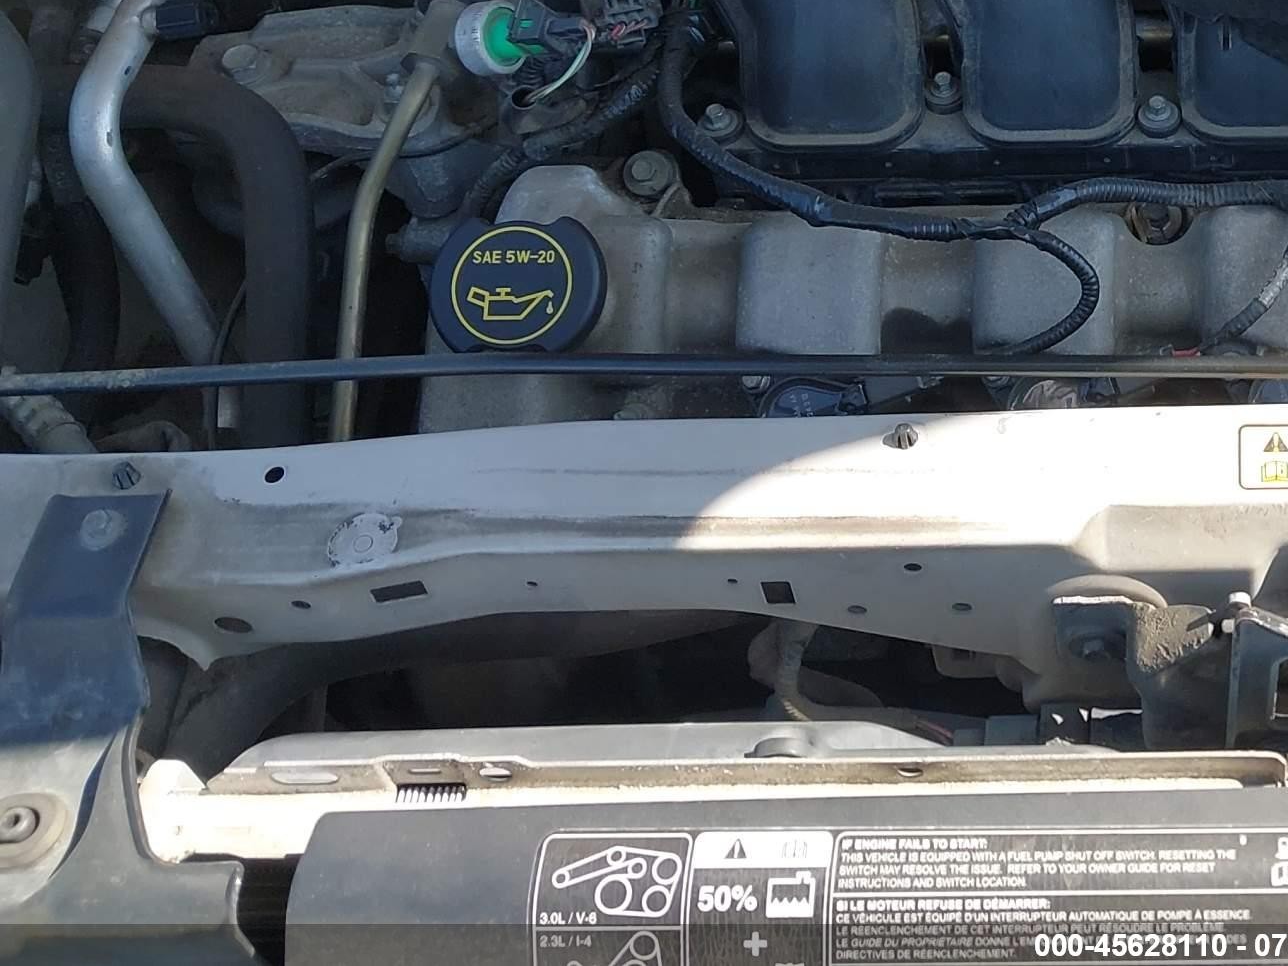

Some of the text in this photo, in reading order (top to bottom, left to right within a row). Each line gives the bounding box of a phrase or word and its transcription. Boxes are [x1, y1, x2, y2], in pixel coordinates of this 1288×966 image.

[472, 250, 555, 264] SAE 5W-20
[855, 839, 898, 850] ENGINE
[899, 839, 930, 850] FAILS
[933, 839, 948, 849] TO
[950, 839, 987, 849] START:
[841, 853, 863, 863] THIS
[865, 852, 907, 862] VEHICLE
[909, 852, 918, 862] IS
[920, 852, 971, 862] EQUIPPED
[972, 852, 997, 862] WITH
[999, 852, 1007, 862] A
[1008, 852, 1032, 861] FUEL
[1035, 851, 1063, 861] PUMP
[1064, 851, 1093, 861] SHUT
[1094, 850, 1114, 861] OFF
[1159, 850, 1215, 860] RESETTING
[1216, 850, 1236, 860] THE
[840, 865, 878, 875] SWITCH
[880, 865, 901, 875] MAY
[902, 864, 947, 875] RESOLVE
[950, 864, 969, 874] THE
[1008, 864, 1041, 874] REFER
[1043, 864, 1057, 874] TO
[1058, 863, 1087, 874] YOUR
[1088, 863, 1126, 873] OWNER
[1127, 863, 1158, 873] GUIDE
[1160, 863, 1181, 873] FOR
[1183, 863, 1216, 873] RESET
[838, 878, 911, 888] INSTRUCTIONS
[913, 877, 934, 888] AND
[936, 877, 974, 888] SWITCH
[697, 885, 758, 912] 50%
[836, 900, 848, 911] SI
[850, 900, 864, 911] LE
[867, 899, 915, 911] MOTEUR
[917, 899, 963, 910] REFUSE
[965, 899, 981, 910] DE
[540, 912, 566, 924] 3.0L
[576, 912, 597, 924] V-6
[836, 913, 850, 924] CE
[904, 913, 922, 923] EST
[990, 911, 1067, 922] INTERRUPTEUR
[1069, 910, 1139, 921] AUTOMATIQUE
[1141, 910, 1155, 921] DE
[1157, 910, 1192, 920] POMPE
[836, 926, 848, 936] LE
[955, 925, 970, 934] DE
[540, 936, 565, 948] 2.3L
[836, 938, 848, 947] LE
[851, 938, 882, 947] GUIDE
[885, 937, 899, 947] DU
[836, 950, 895, 960] DIRECTIVES
[897, 949, 912, 959] DE
